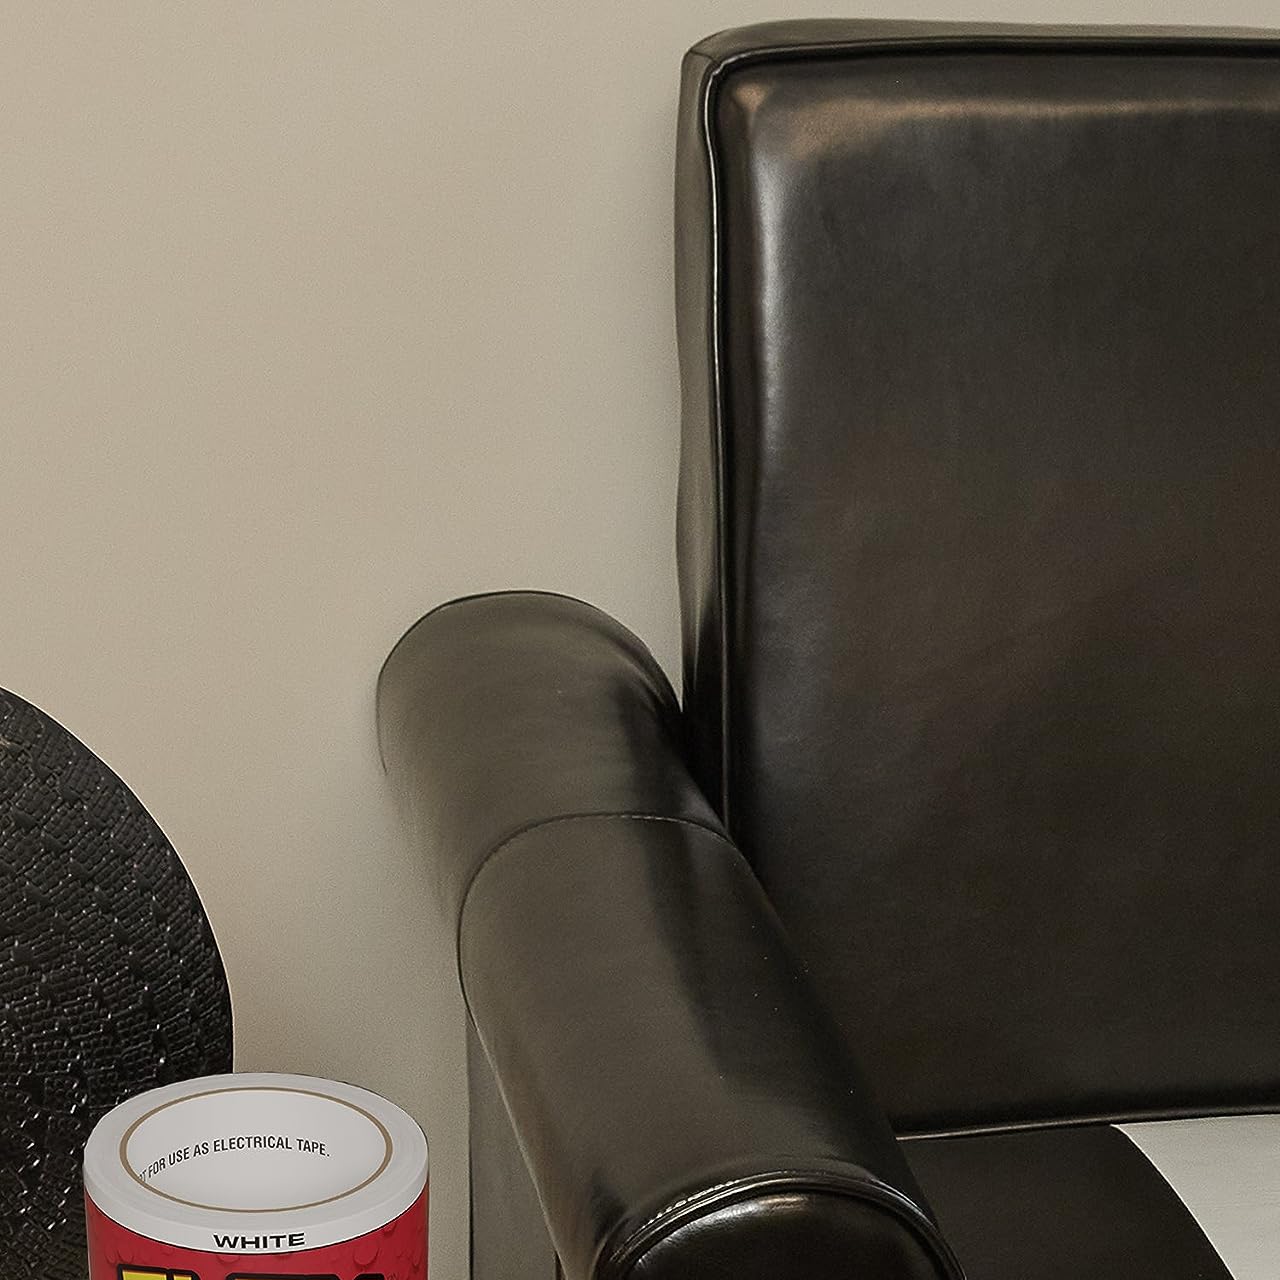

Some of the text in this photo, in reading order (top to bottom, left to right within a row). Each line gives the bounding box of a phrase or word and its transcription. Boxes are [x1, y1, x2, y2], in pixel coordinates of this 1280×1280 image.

[148, 1158, 166, 1179] FOR
[168, 1147, 190, 1166] USE
[193, 1142, 209, 1157] AS
[213, 1135, 292, 1153] ELECTRICAL
[296, 1139, 330, 1157] TAPE.
[213, 1233, 305, 1249] WHITE
